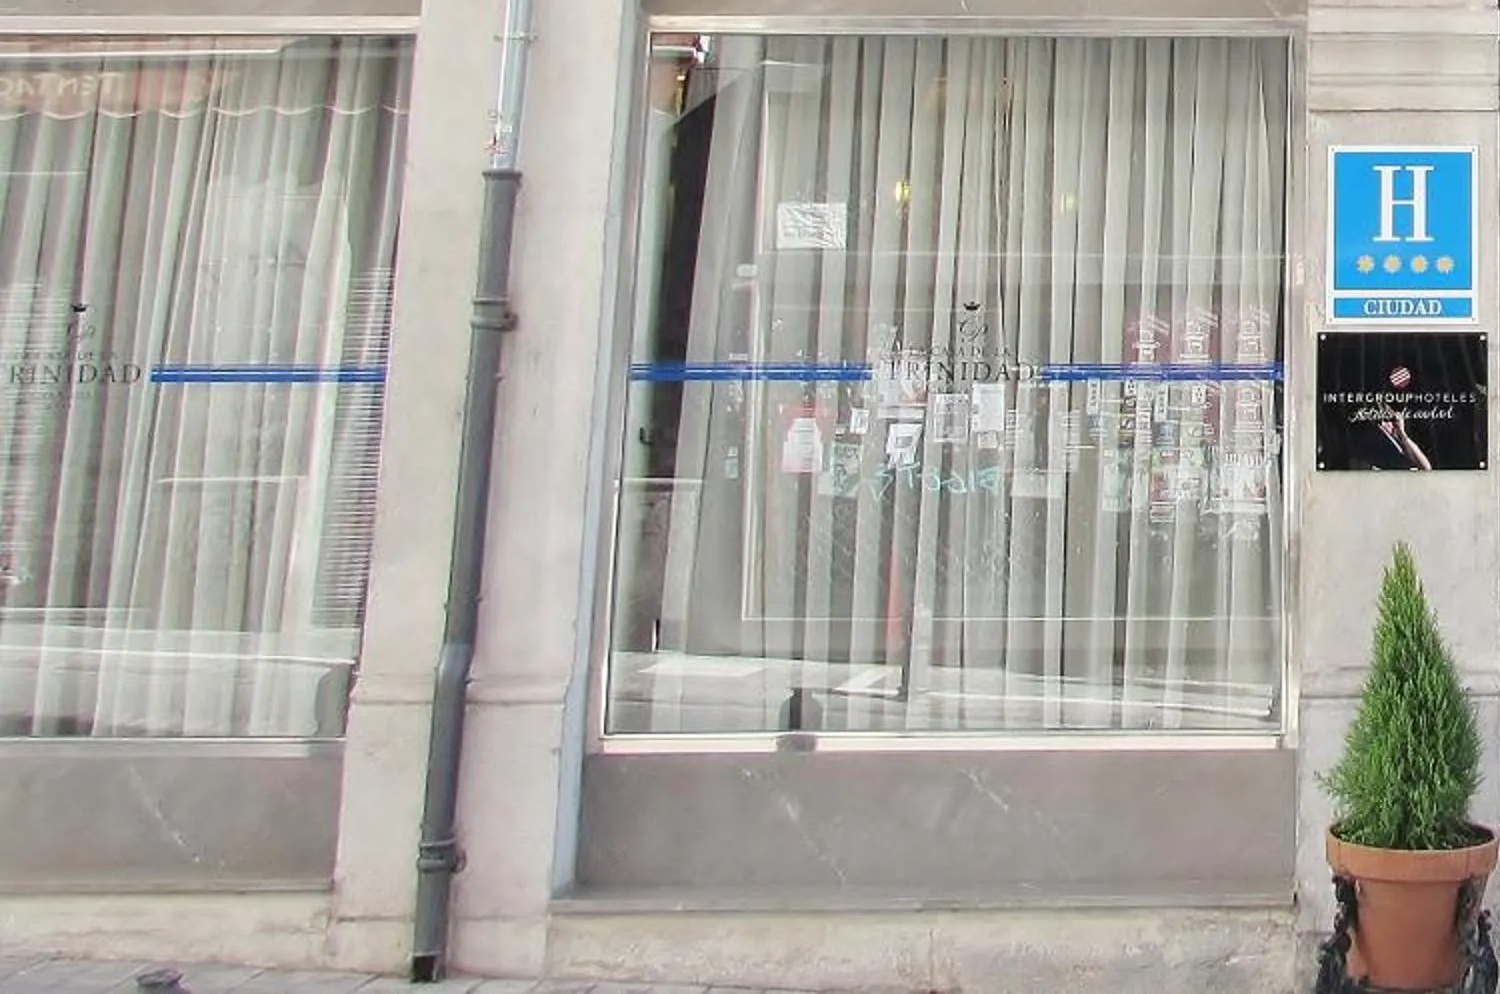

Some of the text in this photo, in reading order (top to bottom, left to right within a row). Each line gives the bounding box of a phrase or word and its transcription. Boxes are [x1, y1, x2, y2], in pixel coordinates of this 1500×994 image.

[1372, 165, 1435, 243] H
[1363, 299, 1442, 316] CIUDAD
[0, 363, 142, 385] RINIDAD
[885, 360, 1036, 382] TRINIDAD
